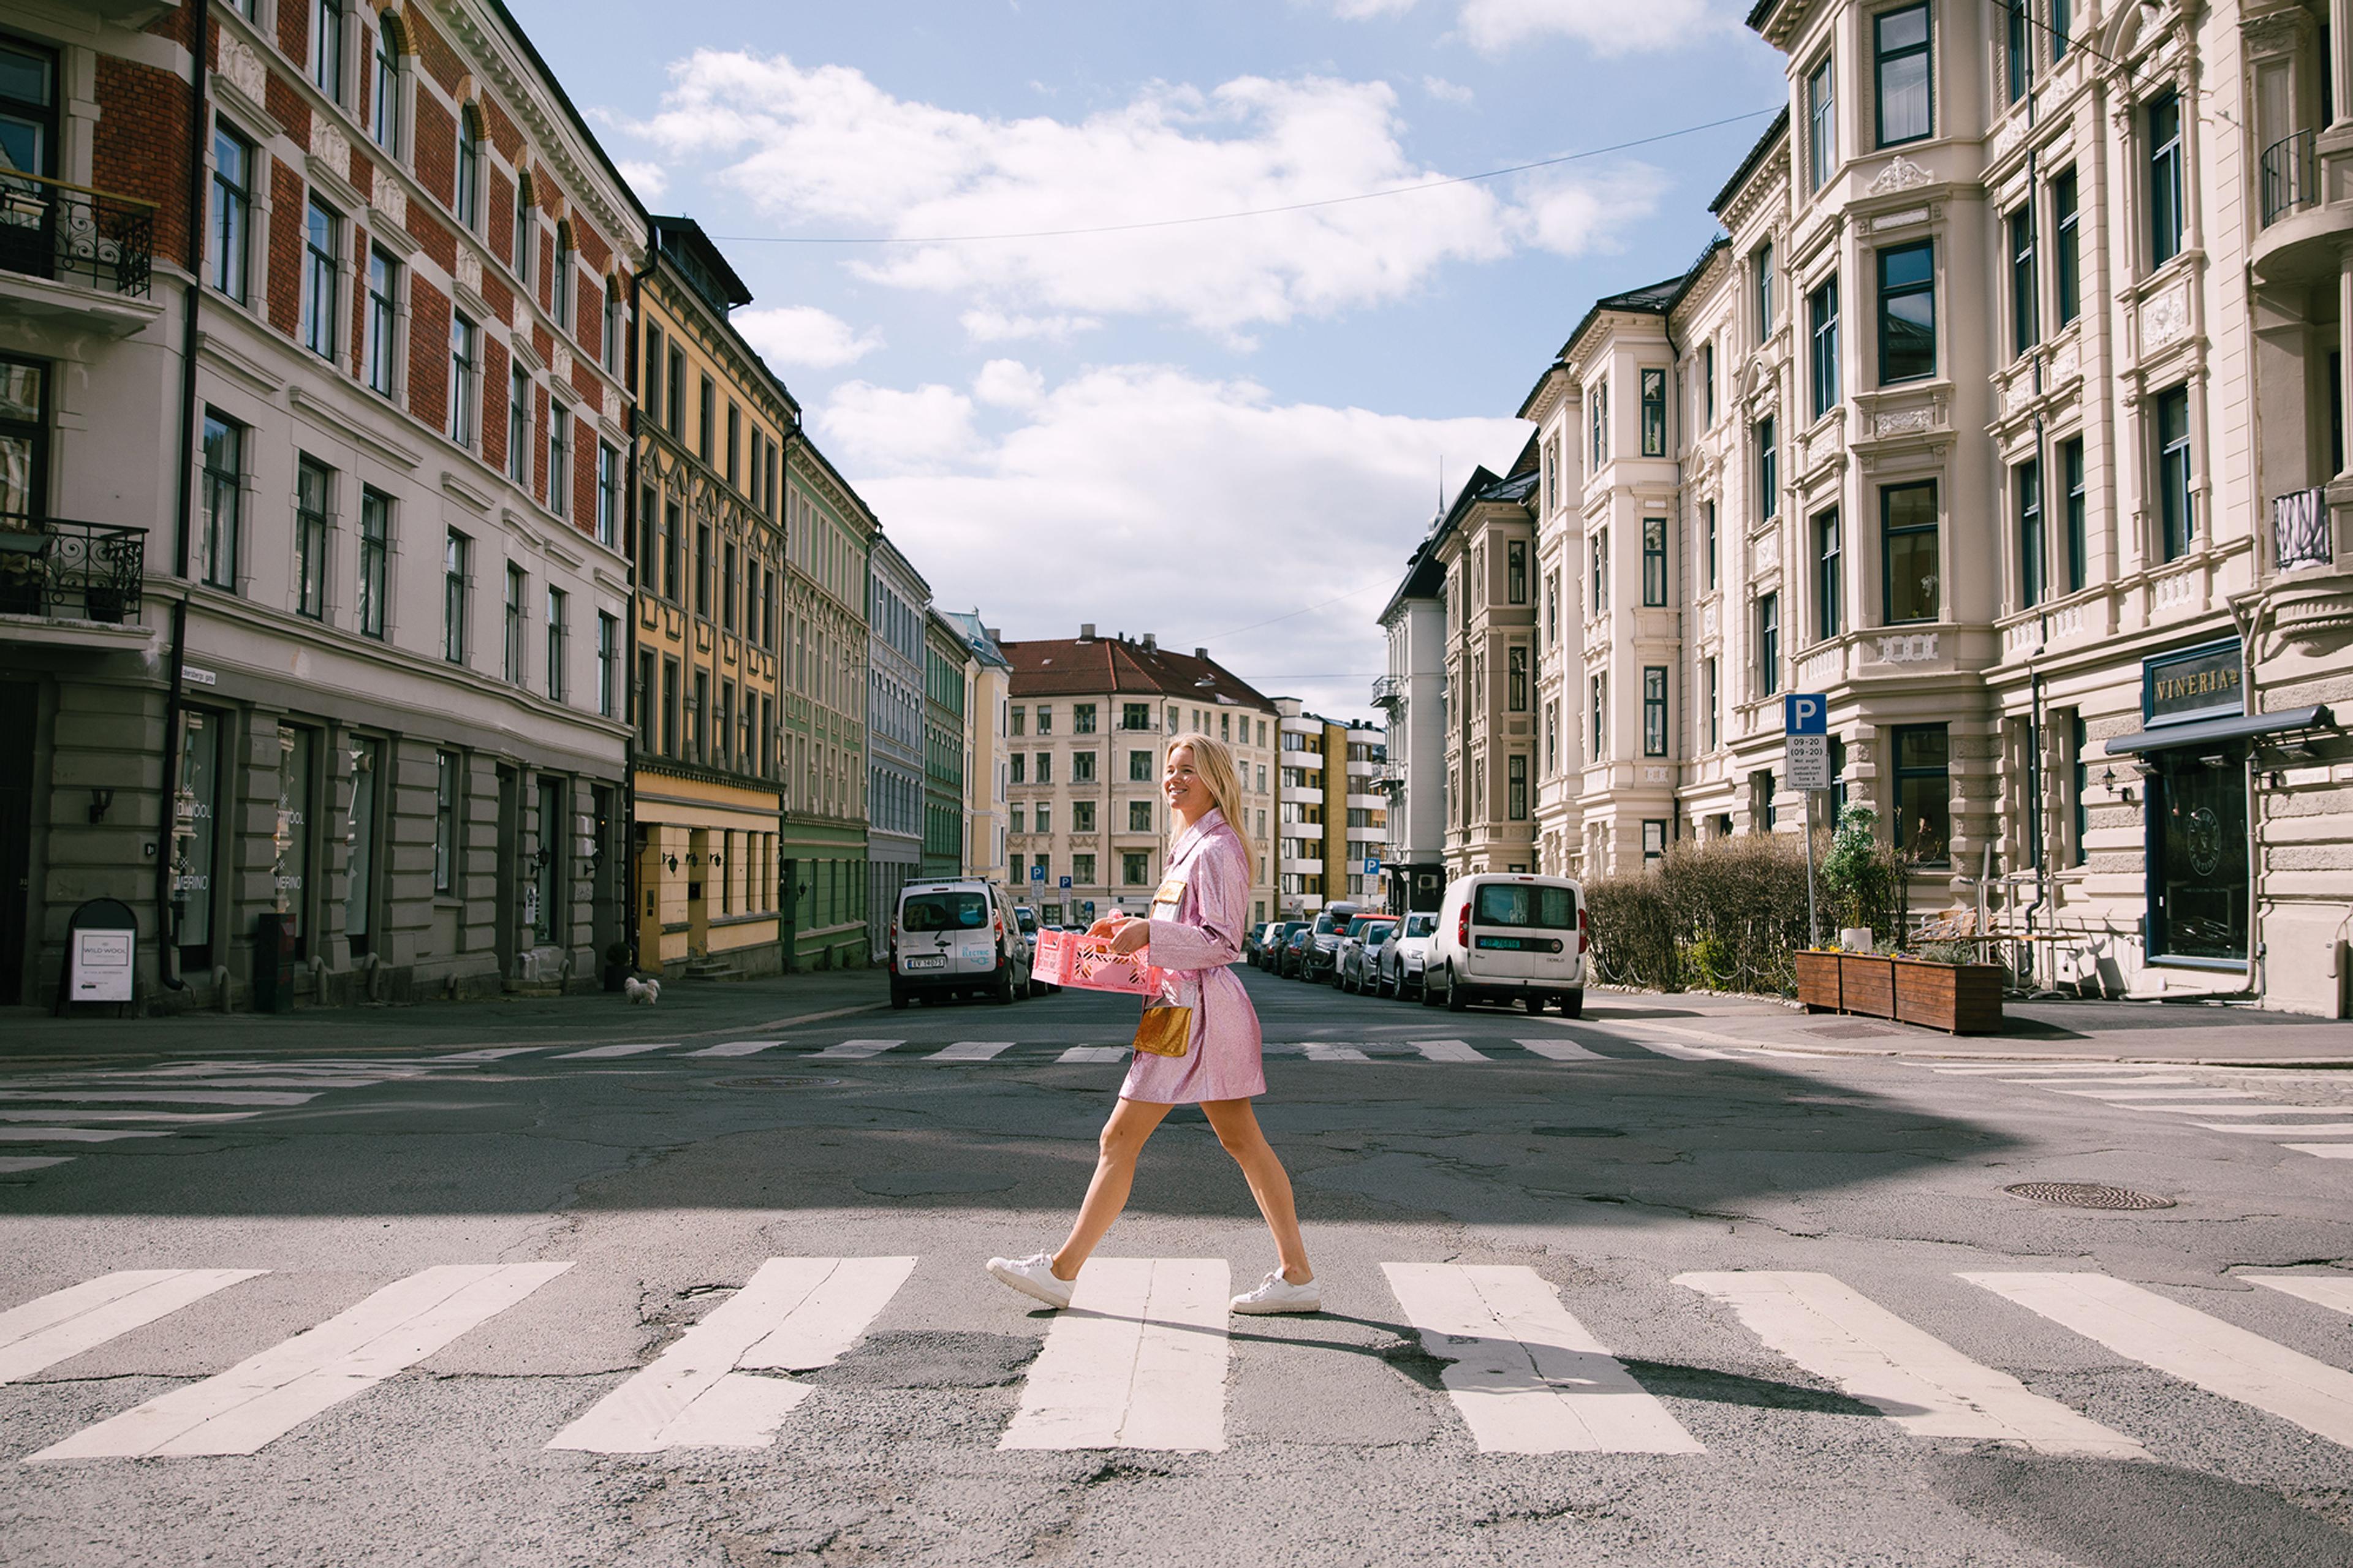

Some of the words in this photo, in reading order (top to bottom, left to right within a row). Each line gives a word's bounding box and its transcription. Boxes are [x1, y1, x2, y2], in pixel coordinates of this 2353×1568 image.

[2156, 669, 2229, 700] VINERIA
[1795, 699, 1816, 729] P
[1367, 860, 1376, 872] P
[1034, 868, 1041, 879] P
[174, 876, 208, 890] MERINO
[1062, 877, 1069, 887] P
